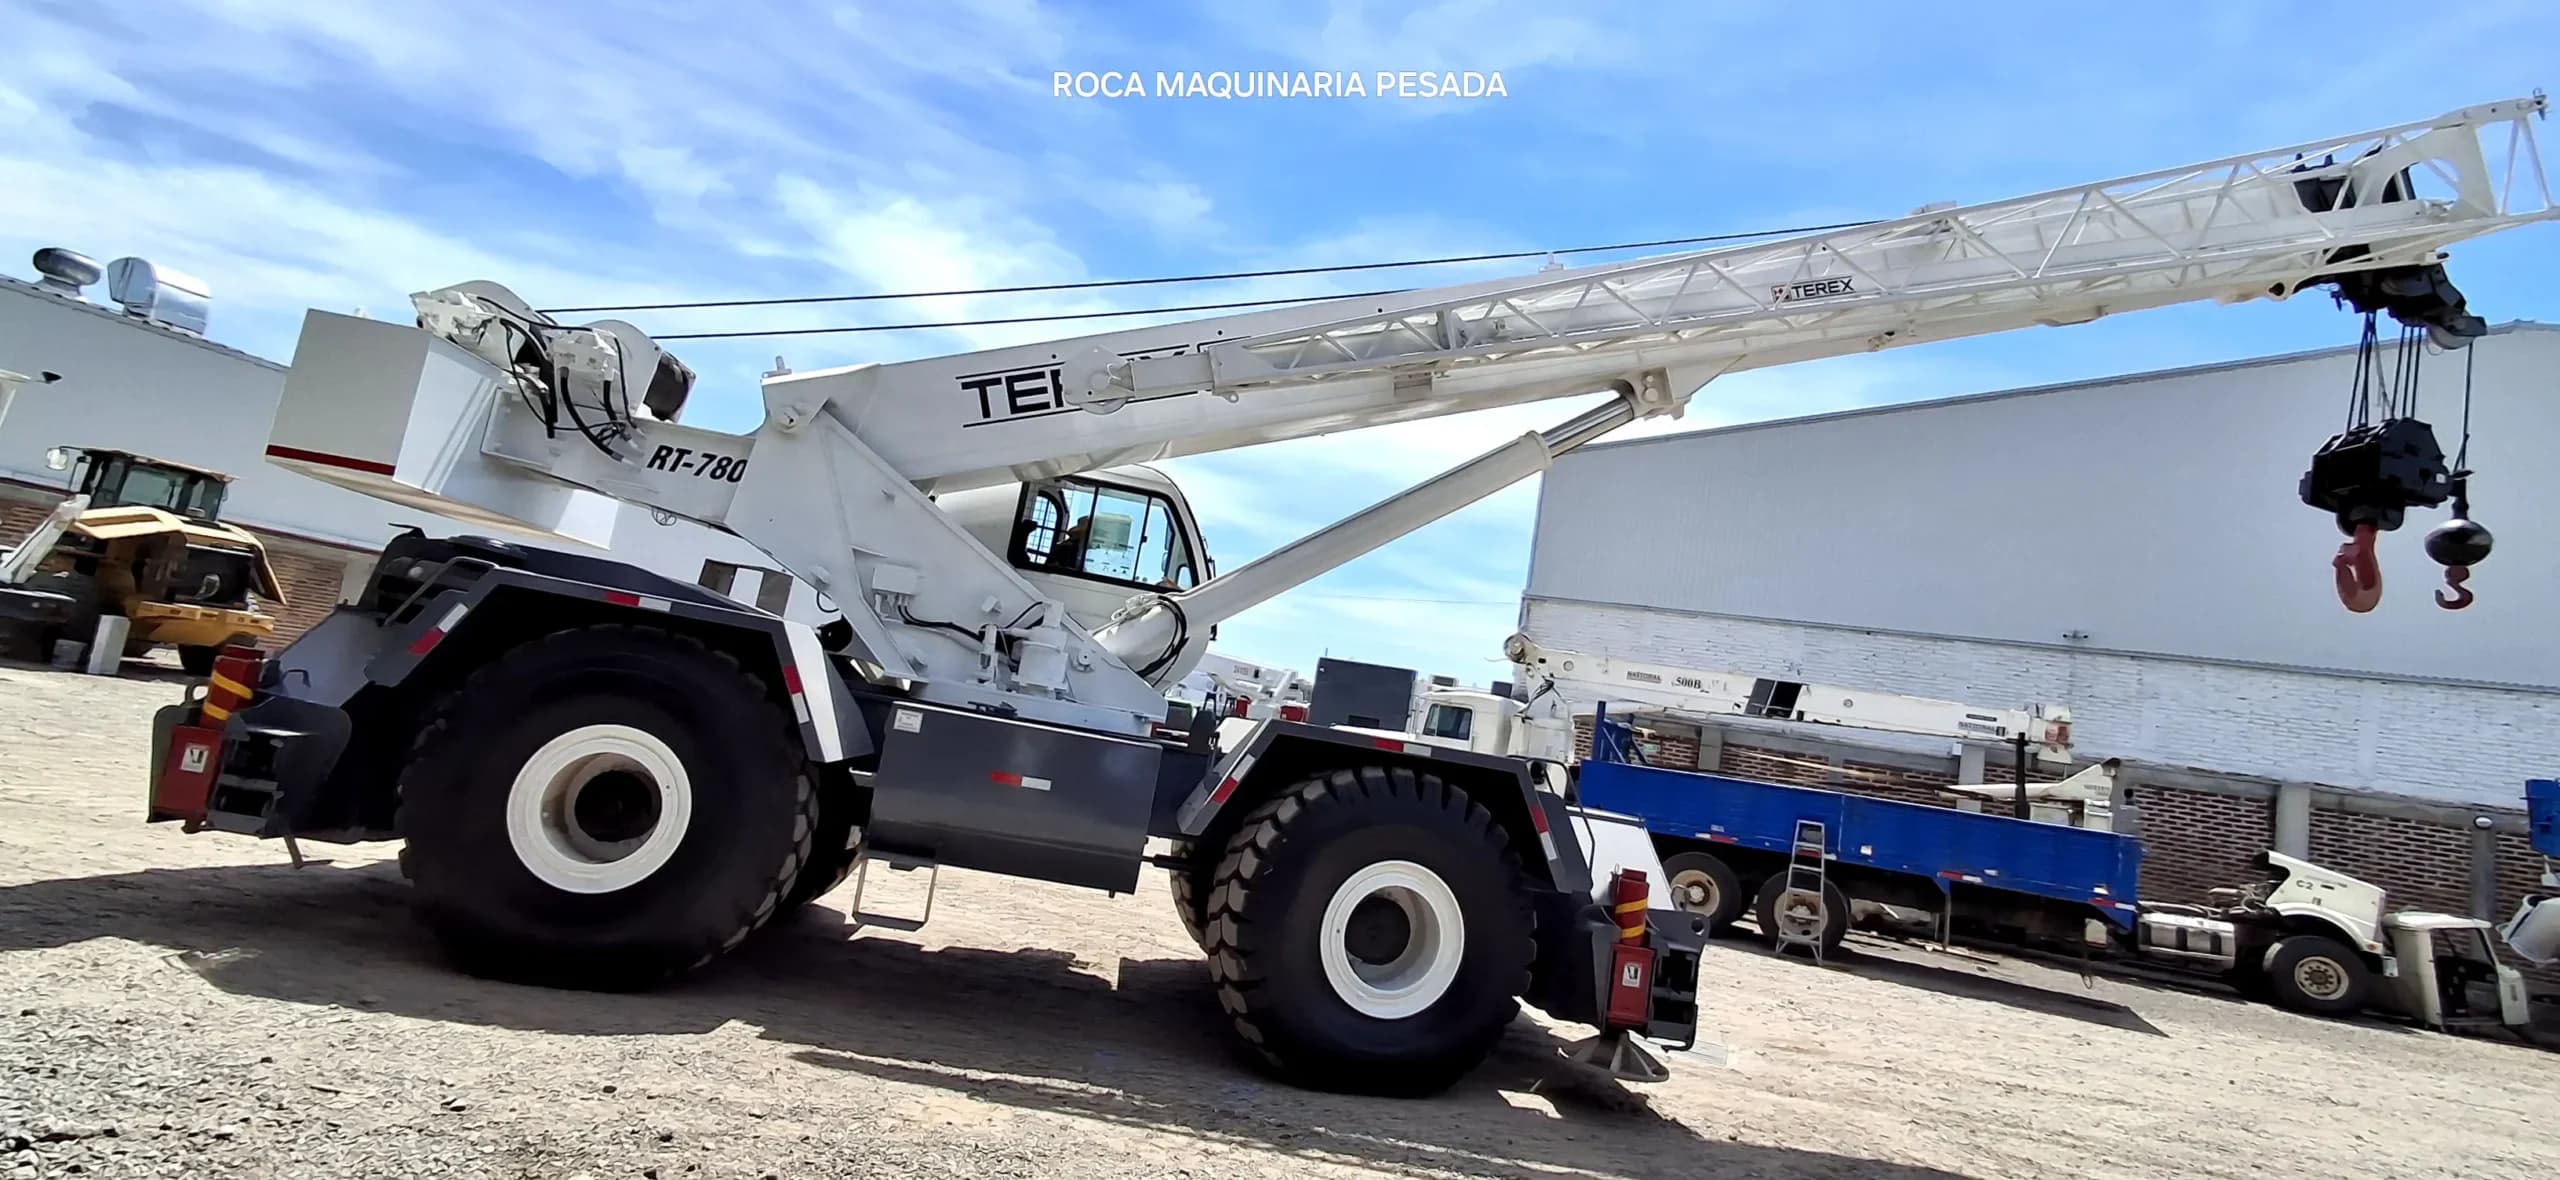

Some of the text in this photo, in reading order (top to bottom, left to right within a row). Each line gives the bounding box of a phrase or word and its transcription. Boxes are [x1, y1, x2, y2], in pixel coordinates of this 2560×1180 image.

[1792, 279, 1854, 298] TEREX
[647, 445, 748, 483] RT-780
[1676, 677, 1701, 689] 500B
